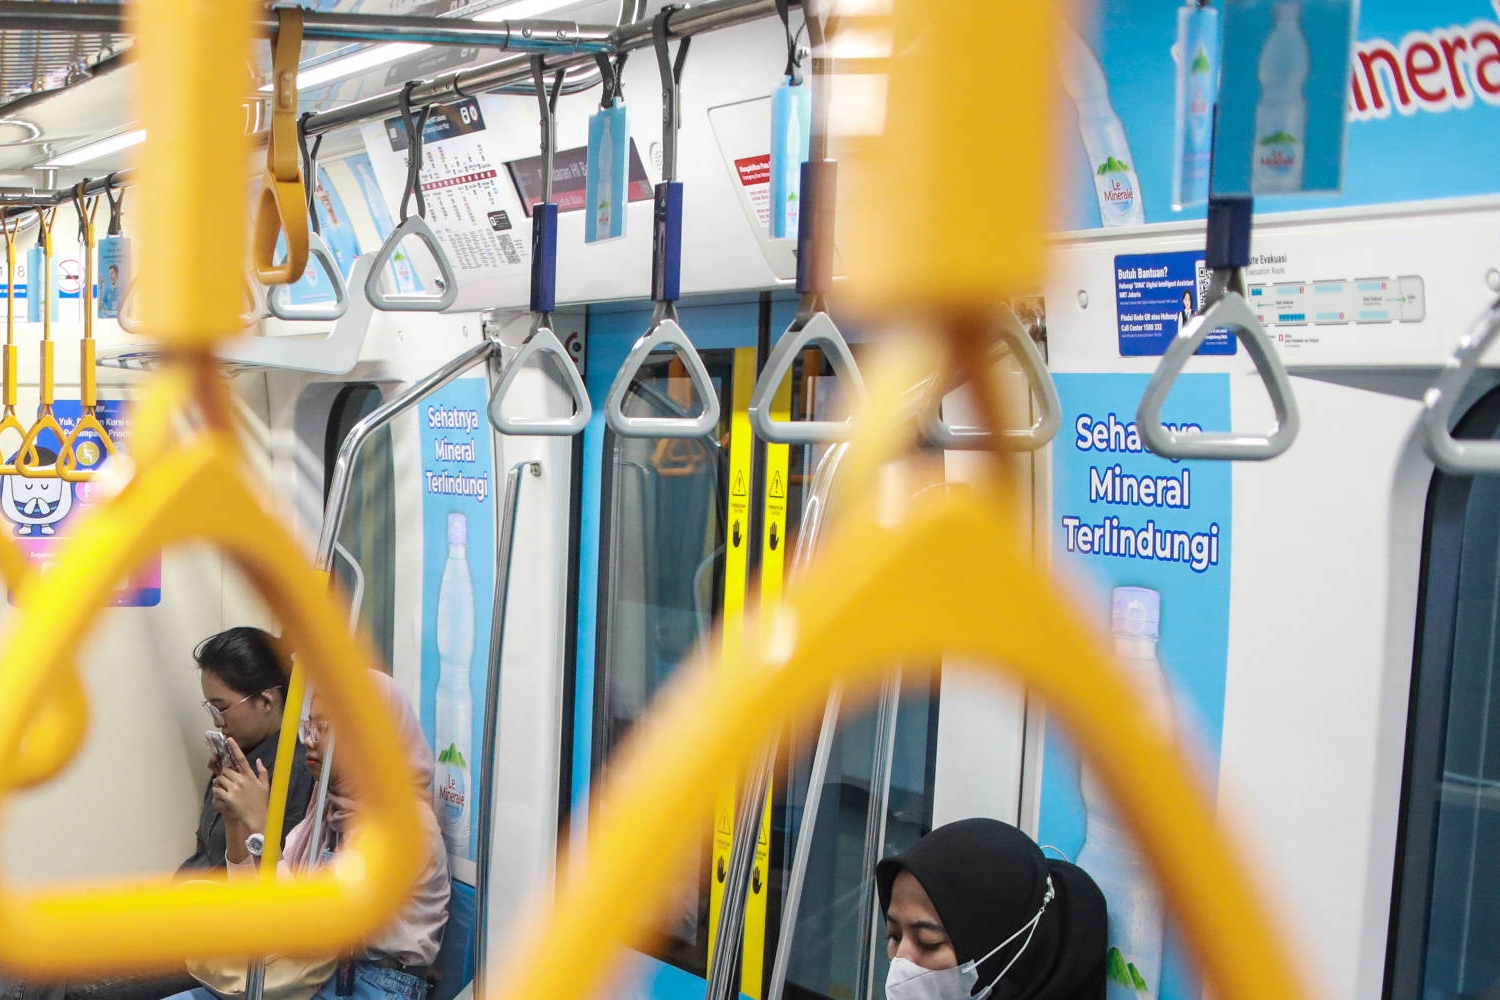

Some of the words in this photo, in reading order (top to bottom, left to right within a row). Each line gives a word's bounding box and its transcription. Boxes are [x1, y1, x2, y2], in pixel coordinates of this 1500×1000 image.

[1104, 188, 1133, 201] Minerale
[1111, 179, 1121, 191] Le
[1260, 253, 1287, 265] Evakuasi
[1117, 268, 1137, 280] Butuh
[1137, 266, 1168, 279] Bantuan?
[59, 417, 75, 427] Yuk,
[105, 418, 125, 427] Kursi
[427, 405, 479, 434] Sehatnya
[434, 437, 476, 462] Mineral
[425, 469, 489, 502] Terlindungi
[1089, 464, 1191, 508] Mineral
[1062, 516, 1220, 573] Terlindungi
[448, 773, 456, 790] Le
[439, 784, 465, 807] Minerale
